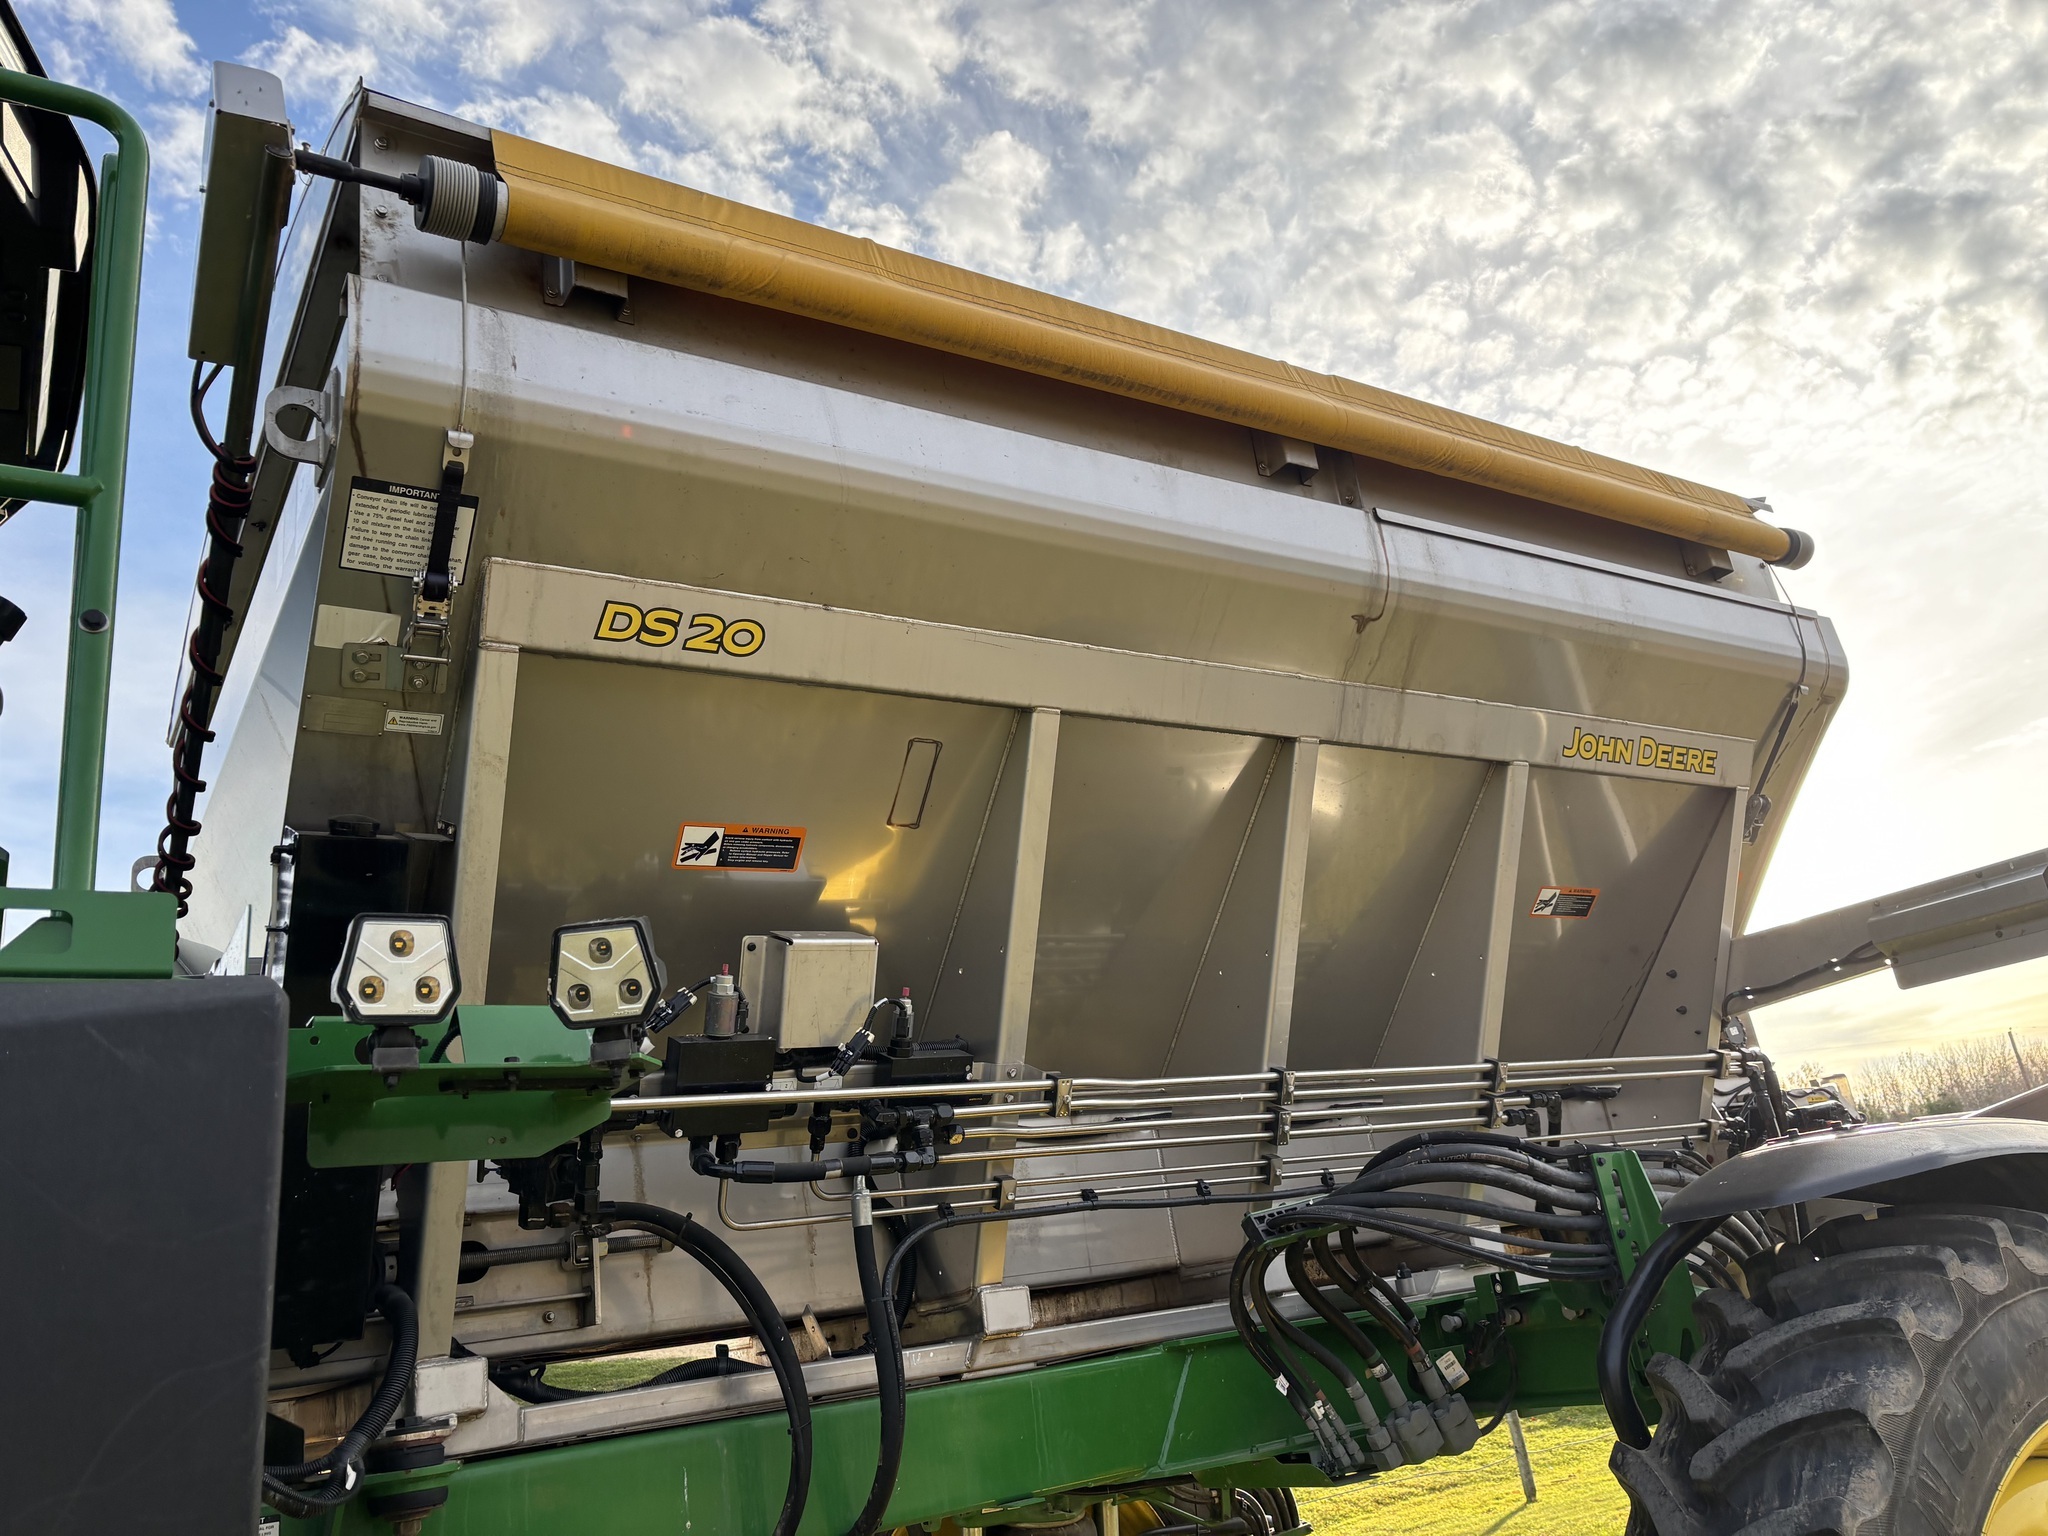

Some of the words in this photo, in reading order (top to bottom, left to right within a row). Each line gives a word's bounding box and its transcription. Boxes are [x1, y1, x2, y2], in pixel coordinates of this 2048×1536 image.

[389, 485, 440, 500] IMPORTAN
[356, 493, 381, 502] Conveyor
[355, 502, 379, 510] extended
[390, 508, 411, 516] periodic
[351, 525, 370, 534] Failure
[375, 539, 396, 547] running
[391, 549, 415, 557] conveyor
[358, 561, 379, 569] voiding
[396, 558, 422, 567] structure,
[593, 600, 684, 648] DS
[681, 613, 766, 658] 20
[1562, 726, 1634, 765] JOHN
[1636, 735, 1718, 775] DEERE
[752, 827, 790, 835] WARNING
